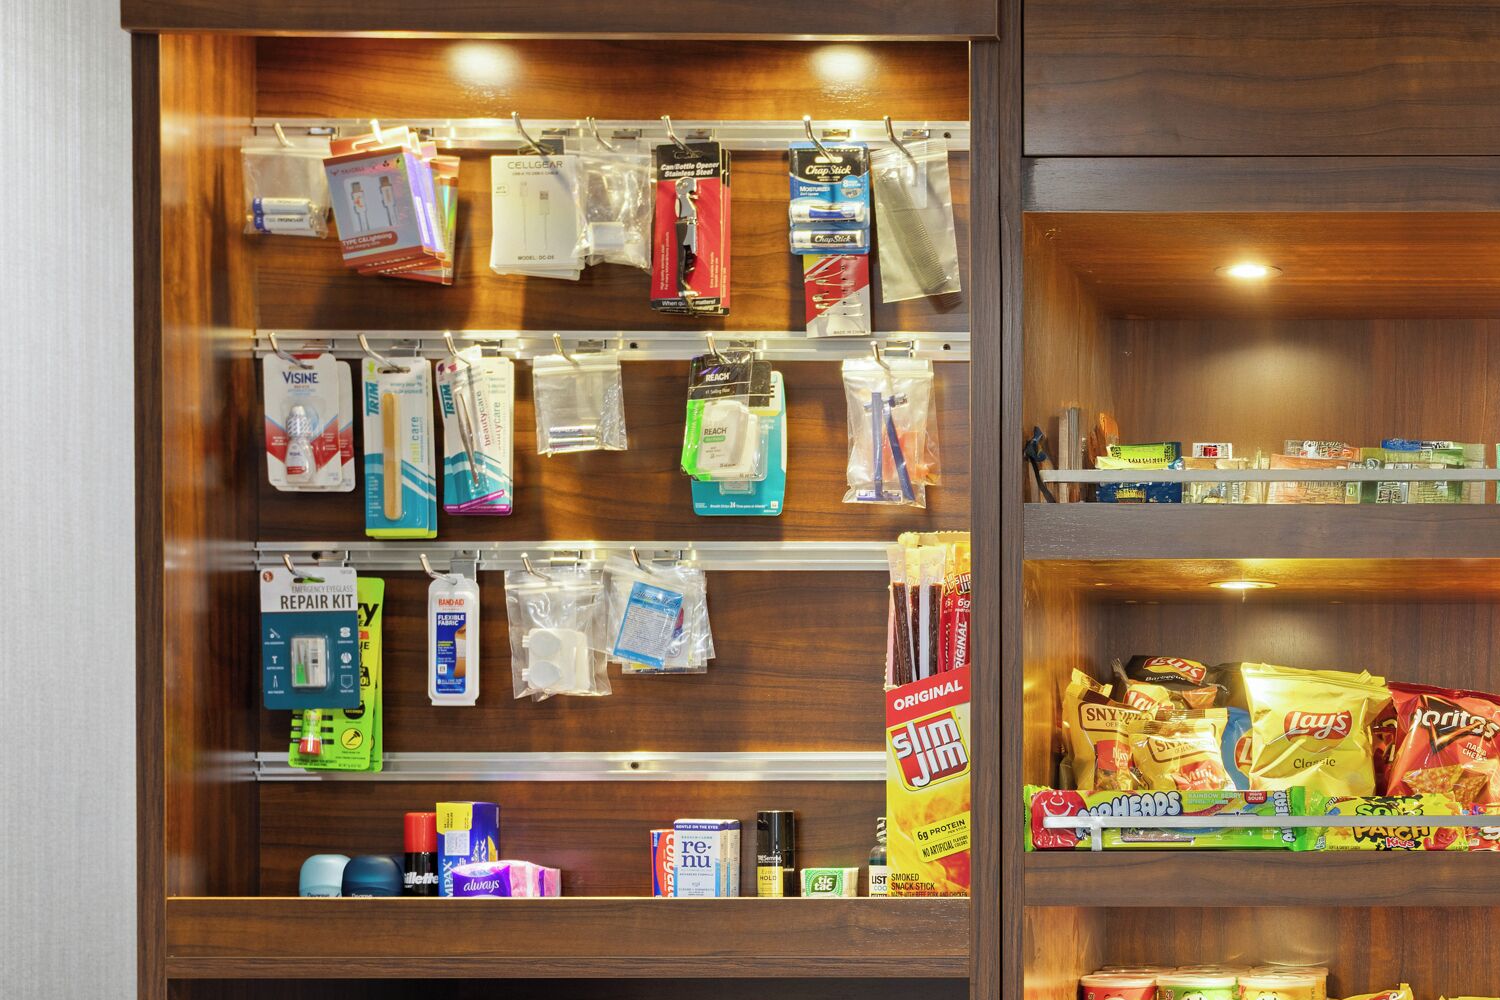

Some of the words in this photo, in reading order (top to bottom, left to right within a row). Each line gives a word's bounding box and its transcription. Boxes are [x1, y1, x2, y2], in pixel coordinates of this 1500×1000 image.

[507, 161, 563, 170] CELLGEAR
[661, 163, 694, 171] Can/Bottle
[805, 165, 851, 175] ChapStick
[664, 170, 694, 178] Stainless
[695, 168, 713, 176] Steel
[814, 234, 851, 243] ChapStick
[283, 372, 319, 384] VISINE
[706, 372, 730, 382] REACH
[365, 382, 379, 416] TRIM
[440, 384, 455, 418] TRIM
[704, 427, 726, 435] REACH
[292, 586, 325, 594] EMERGENCY
[280, 595, 328, 610] REPAIR
[333, 594, 353, 608] KIT
[893, 680, 963, 711] ORIGINAL
[1288, 711, 1351, 741] Lay's
[917, 831, 928, 840] 6g
[930, 819, 965, 836] PROTEIN
[922, 848, 930, 857] NO
[930, 841, 954, 855] ARTIFICIAL
[682, 854, 711, 868] nu
[818, 876, 833, 884] tic
[891, 873, 919, 881] SMOKED
[464, 879, 499, 893] always
[813, 882, 833, 891] tac
